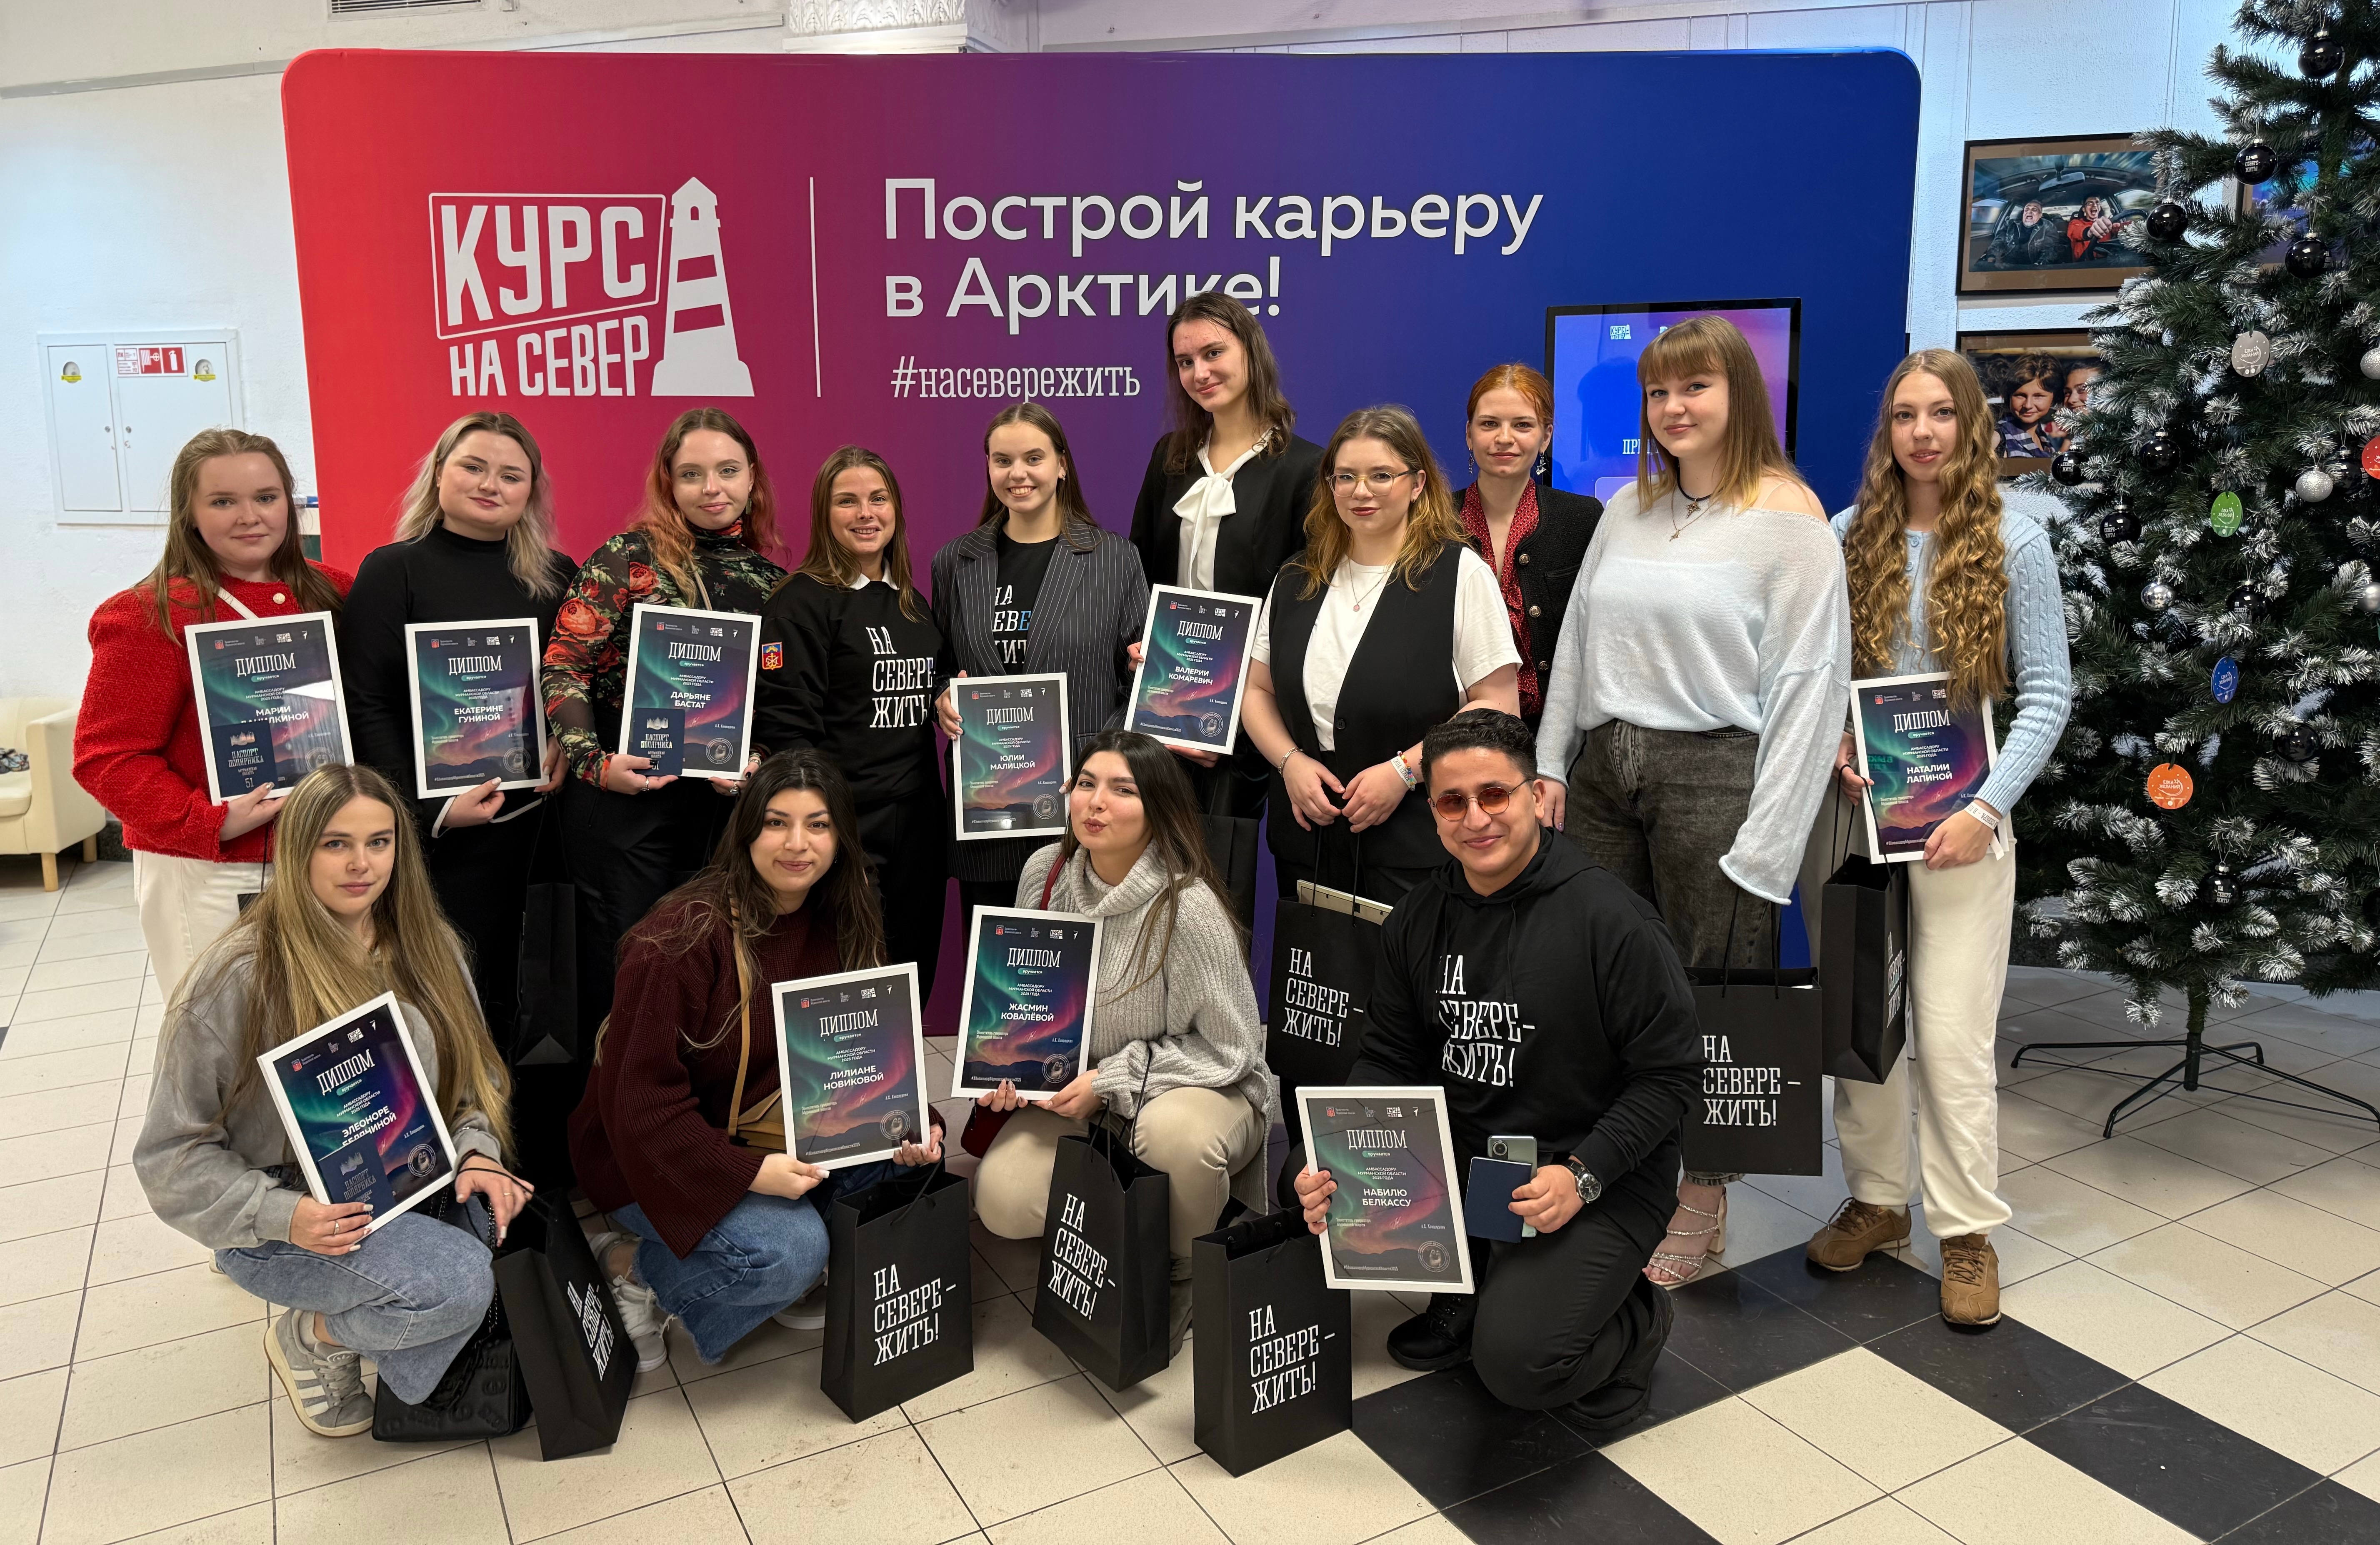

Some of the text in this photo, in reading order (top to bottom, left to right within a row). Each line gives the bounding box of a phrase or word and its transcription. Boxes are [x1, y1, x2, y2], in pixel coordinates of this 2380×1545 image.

[885, 178, 1544, 257] Построй карьеру
[441, 205, 646, 326] КУРС
[886, 256, 1280, 335] в Арктике!
[449, 315, 650, 396] НА СЕВЕР
[890, 356, 1140, 405] #насевережить
[992, 610, 1031, 632] ЕВЕ
[1177, 620, 1222, 640] ДИПЛОМ
[866, 626, 897, 654] НА
[668, 642, 721, 661] ДИПЛОМ
[235, 653, 295, 677] ДИПЛОМ
[448, 655, 502, 675] ДИПЛОМ
[1175, 666, 1208, 676] ВАЛЕРИИ
[1168, 673, 1212, 685] КОМАРЕВИЧ
[670, 691, 710, 700] ДАРЬЯНЕ
[675, 700, 705, 708] БАСТАТ
[241, 711, 308, 723] ЛКИНОЙ
[255, 705, 290, 716] МАРИИ
[454, 705, 503, 715] ЕКАТЕРИНЕ
[458, 713, 500, 722] ГУНИНОЙ
[986, 707, 1033, 725] ДИПЛОМ
[1893, 709, 1950, 732] ДИПЛОМ
[228, 755, 263, 767] ПОЛЯРНИКА
[231, 748, 258, 759] ПАСПОРТ
[990, 760, 1035, 770] МАЛИЦКОЙ
[1906, 763, 1949, 774] НАТАЛИИ
[245, 777, 254, 788] 51
[1906, 772, 1952, 783] ЛАПИНОЙ
[1007, 948, 1061, 967] ДИПЛОМ
[1289, 948, 1312, 978] НА
[1001, 1012, 1053, 1021] КОВАЛЁВОЙ
[1009, 1002, 1047, 1012] ЖАСМИН
[819, 1009, 878, 1036] ДИПЛОМ
[1282, 1007, 1342, 1048] ЖИТЬ!
[1702, 1035, 1733, 1062] НА
[316, 1048, 375, 1095] ДИПЛОМ
[823, 1072, 883, 1090] НОВИКОВОЙ
[830, 1065, 876, 1079] ЛИЛИАНЕ
[342, 1105, 389, 1137] ЭЛЕОНОРЕ
[1703, 1098, 1777, 1126] ЖИТЬ!
[1346, 1130, 1407, 1149] ДИПЛОМ
[1363, 1188, 1406, 1196] НАБИЛЮ
[1060, 1193, 1085, 1232] НА
[1362, 1198, 1410, 1207] БЕЛКАССУ
[873, 1264, 901, 1301] НА
[1048, 1260, 1097, 1320] ЖИТЬ!
[568, 1281, 582, 1318] НА
[1249, 1305, 1276, 1342] НА
[592, 1314, 614, 1381] ЖИТЬ!
[874, 1312, 938, 1366] ЖИТЬ!
[1251, 1361, 1315, 1414] ЖИТЬ!
